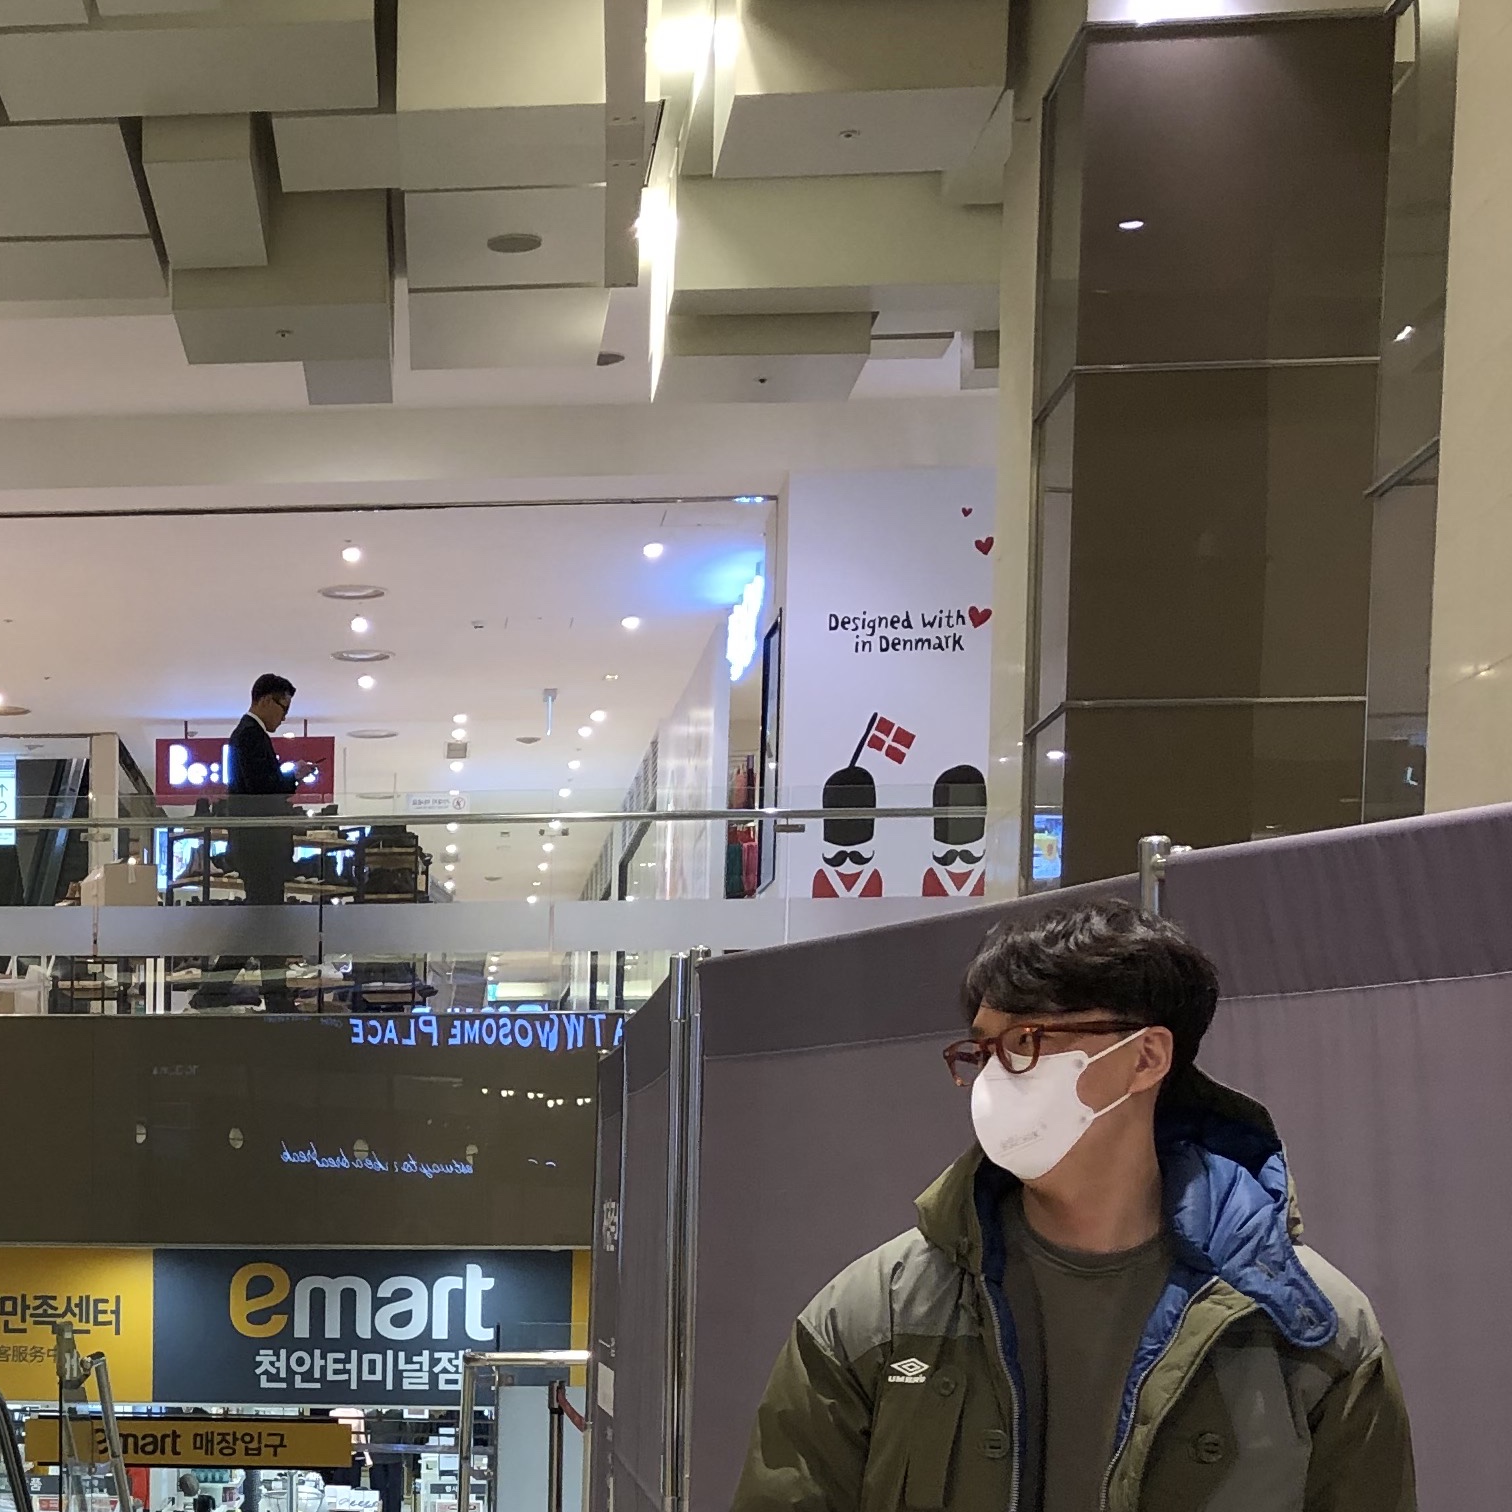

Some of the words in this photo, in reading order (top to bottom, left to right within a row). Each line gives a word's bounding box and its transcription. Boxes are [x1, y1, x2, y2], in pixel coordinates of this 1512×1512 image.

[828, 611, 913, 636] Designed
[854, 634, 872, 653] in
[879, 633, 966, 653] Denmark
[229, 1262, 495, 1341] emart
[254, 1348, 472, 1391] 천안터미널점
[192, 1431, 288, 1458] 매장입구
